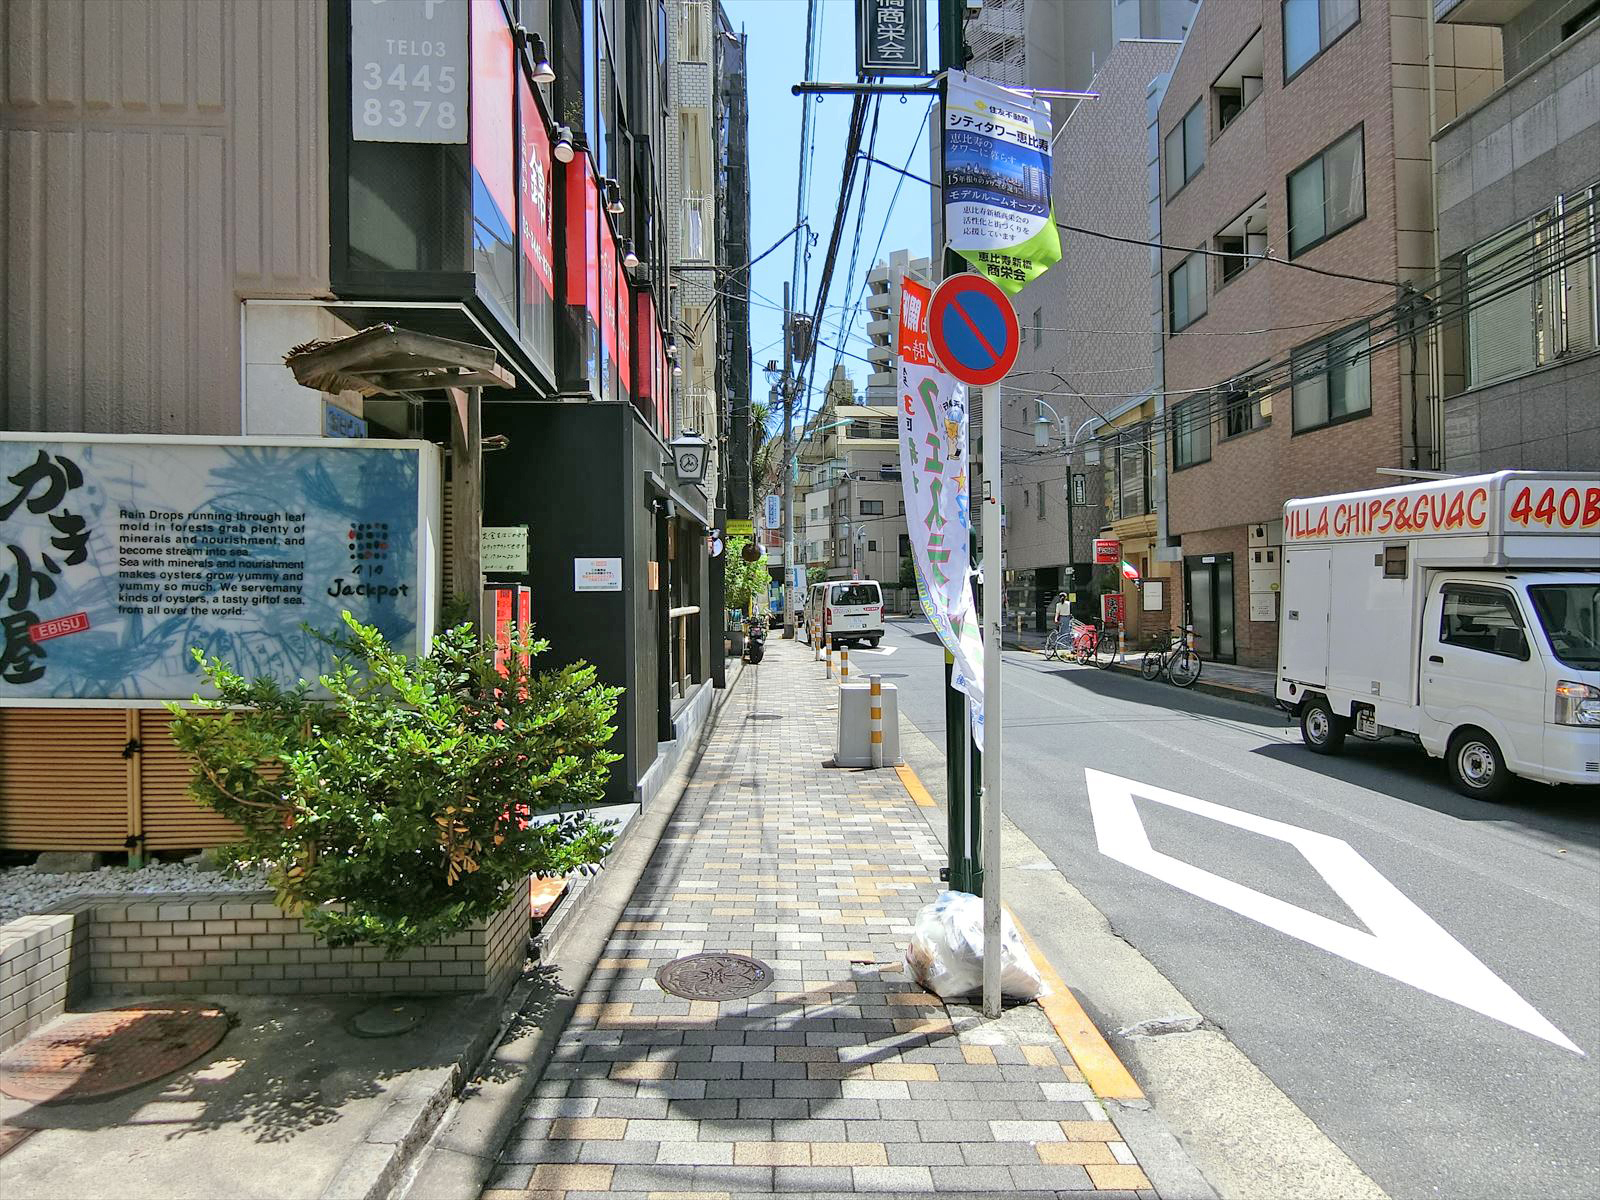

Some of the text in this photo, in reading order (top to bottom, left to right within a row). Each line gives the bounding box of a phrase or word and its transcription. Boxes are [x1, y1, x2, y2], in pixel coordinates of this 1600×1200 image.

[877, 0, 905, 59] 商栄会
[362, 62, 456, 94] 3445
[362, 98, 457, 130] 8378
[989, 105, 1029, 124] 住友不動産
[950, 113, 1049, 152] シティタワー恵比寿
[949, 190, 1045, 214] モデルルームオープン
[963, 216, 1030, 235] 活性化と街づくりを
[963, 227, 1017, 241] 応援しています
[978, 251, 1033, 270] 恵比寿新橋
[987, 263, 1026, 282] 商栄会
[119, 510, 306, 523] Rain Drops running through leaf
[1285, 487, 1487, 540] ILLA CHIPS&GUAC
[119, 522, 305, 535] mold in forests grab plenty of
[119, 534, 171, 544] minerals
[175, 535, 197, 544] and
[284, 537, 305, 546] and
[119, 546, 163, 555] become
[165, 547, 202, 555] stream
[206, 547, 226, 556] into
[0, 449, 92, 685] かき小屋
[119, 558, 304, 569] Sea with minerals and nourishment
[119, 570, 304, 582] makes oysters grow yummy and
[119, 583, 160, 592] yummy
[220, 583, 238, 592] We
[327, 578, 409, 604] Jackpot
[118, 593, 148, 602] kinds
[151, 594, 163, 602] of
[222, 595, 248, 605] tasty
[118, 605, 144, 614] from
[147, 605, 160, 614] all
[163, 607, 187, 615] over
[191, 606, 208, 615] the
[38, 618, 82, 638] EBISU
